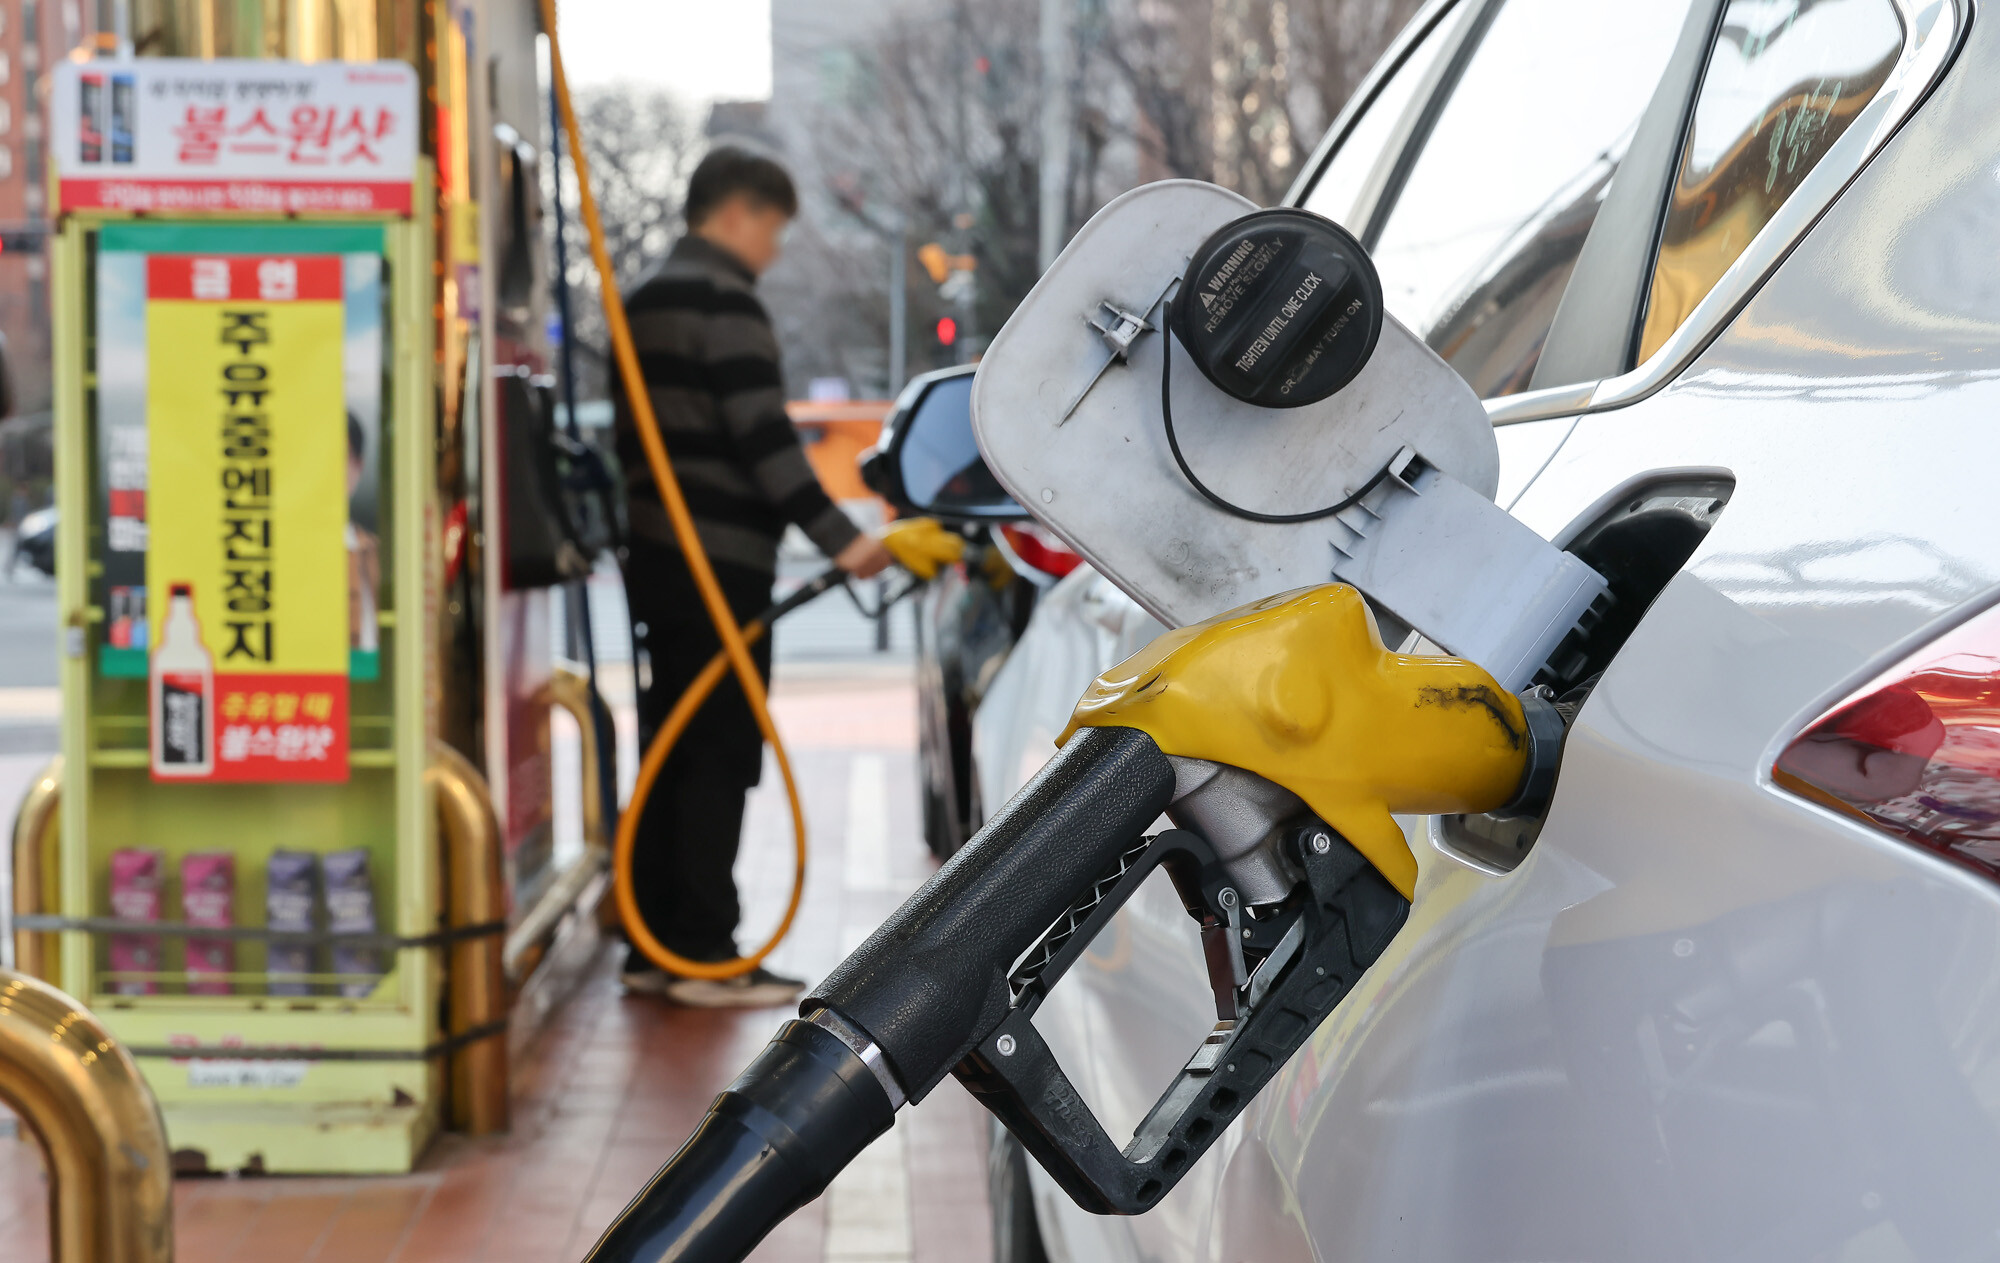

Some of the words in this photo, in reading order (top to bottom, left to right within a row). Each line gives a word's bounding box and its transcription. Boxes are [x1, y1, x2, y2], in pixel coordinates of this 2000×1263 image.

[174, 104, 395, 165] 불스원샷
[1204, 284, 1246, 333] REMOVE
[1242, 237, 1284, 285] SLOWLY
[1208, 239, 1256, 292] WARNING
[1235, 336, 1271, 372] TIGHTEN
[1262, 316, 1289, 341] UNTIL
[1281, 296, 1303, 318] ONE
[1295, 272, 1322, 301] CLICK
[1280, 378, 1297, 394] OR
[1305, 341, 1325, 366] MAY
[1323, 315, 1349, 342] TURN
[1346, 299, 1363, 316] ON
[219, 723, 335, 762] 불스원샷
